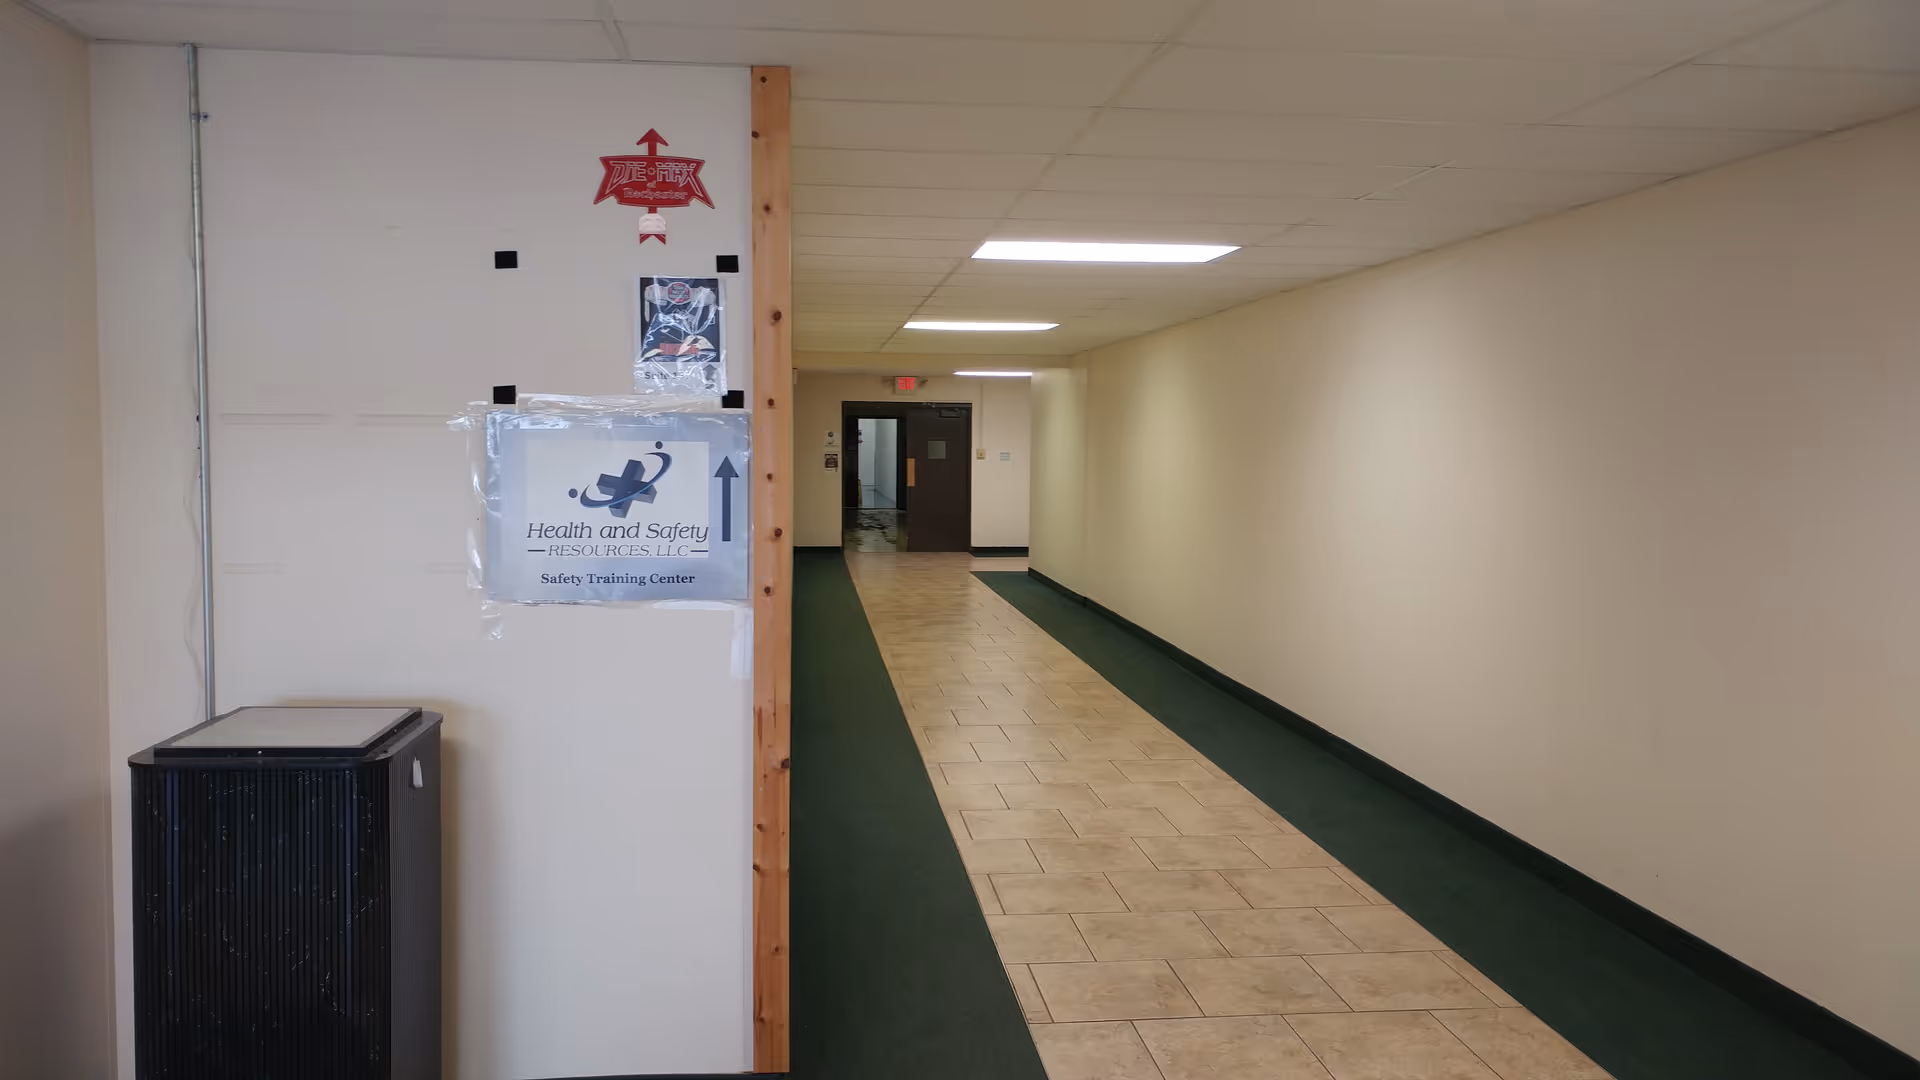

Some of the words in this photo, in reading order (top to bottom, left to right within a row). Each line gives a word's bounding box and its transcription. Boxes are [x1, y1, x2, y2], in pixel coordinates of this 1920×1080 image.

[655, 162, 704, 197] MAX
[623, 187, 688, 200] Rochester
[527, 522, 592, 539] Health
[600, 522, 640, 539] and
[646, 522, 708, 542] Safety
[656, 545, 689, 557] LLC
[541, 573, 584, 586] Safety
[587, 573, 647, 586] Training
[650, 573, 696, 584] Center
